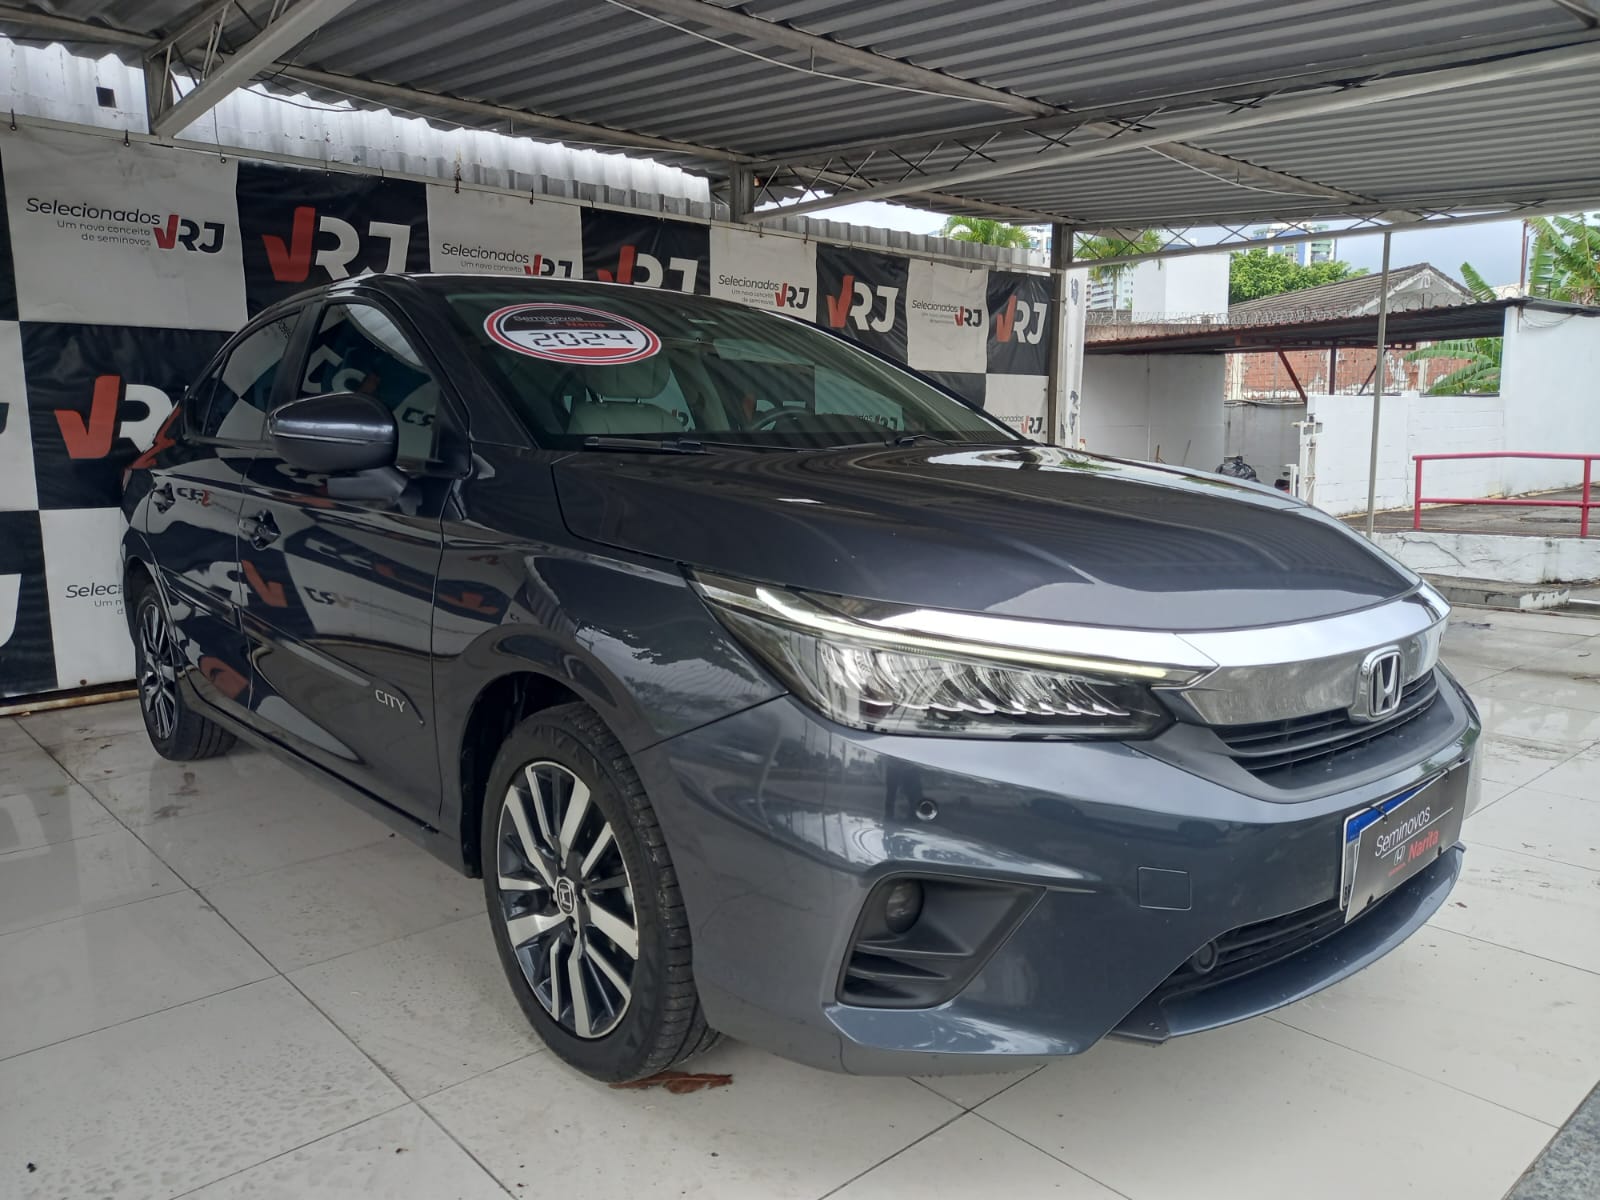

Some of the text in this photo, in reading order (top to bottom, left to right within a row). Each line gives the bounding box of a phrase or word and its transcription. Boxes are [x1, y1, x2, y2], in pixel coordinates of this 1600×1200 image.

[26, 197, 225, 254] Selecionados VRJ
[57, 220, 150, 236] Um novo conceito
[81, 232, 151, 246] de seminovos
[262, 206, 411, 283] VRJ
[442, 243, 529, 264] Selecionados
[718, 274, 810, 309] Selecionados VRJ
[826, 274, 899, 332] VRJ
[912, 300, 982, 327] Selecionados VRJ
[996, 294, 1047, 345] VRJ
[529, 332, 633, 347] 2024
[54, 375, 175, 460] VR
[94, 600, 112, 608] Um
[375, 689, 406, 713] CITY
[1375, 806, 1431, 857] Seminovos
